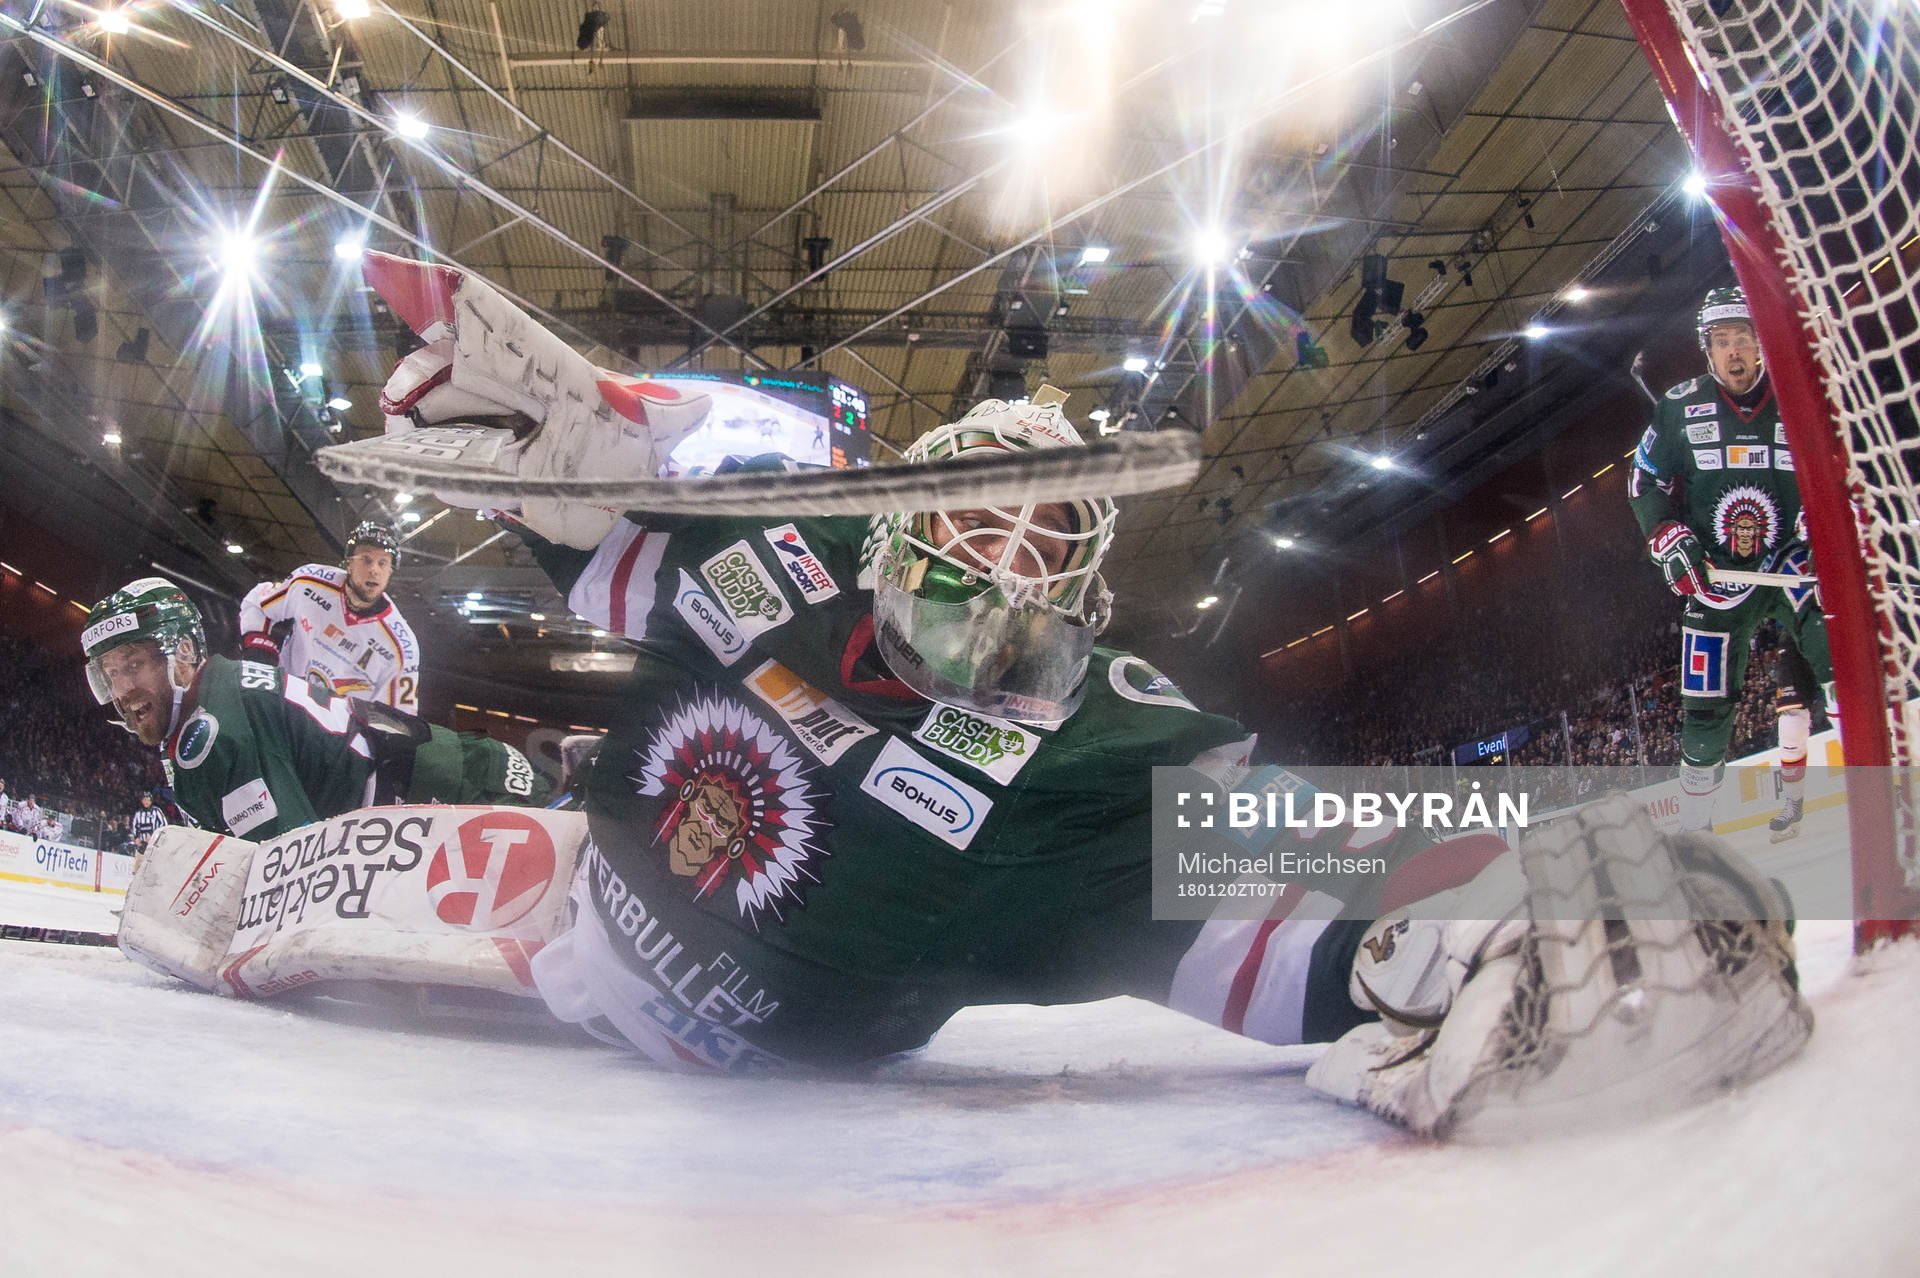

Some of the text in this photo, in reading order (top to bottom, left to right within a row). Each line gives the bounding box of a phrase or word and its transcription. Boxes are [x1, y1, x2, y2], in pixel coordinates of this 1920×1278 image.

[845, 411, 854, 425] 2
[708, 560, 760, 618] BUDDY
[725, 551, 766, 600] CASH
[786, 560, 818, 595] SPORT
[799, 554, 832, 591] INTER
[84, 615, 133, 644] URFORS
[690, 598, 735, 646] BOHUS
[400, 676, 418, 706] 2
[925, 723, 1003, 767] BUDDY
[936, 706, 999, 747] CASH
[228, 800, 265, 827] KUMHO TYRE
[890, 775, 959, 825] BOHUS
[36, 845, 89, 872] OffiTech
[262, 816, 434, 884] Service
[176, 861, 225, 917] VAPOR
[236, 863, 386, 932] Reklam
[708, 951, 780, 1020] FILM
